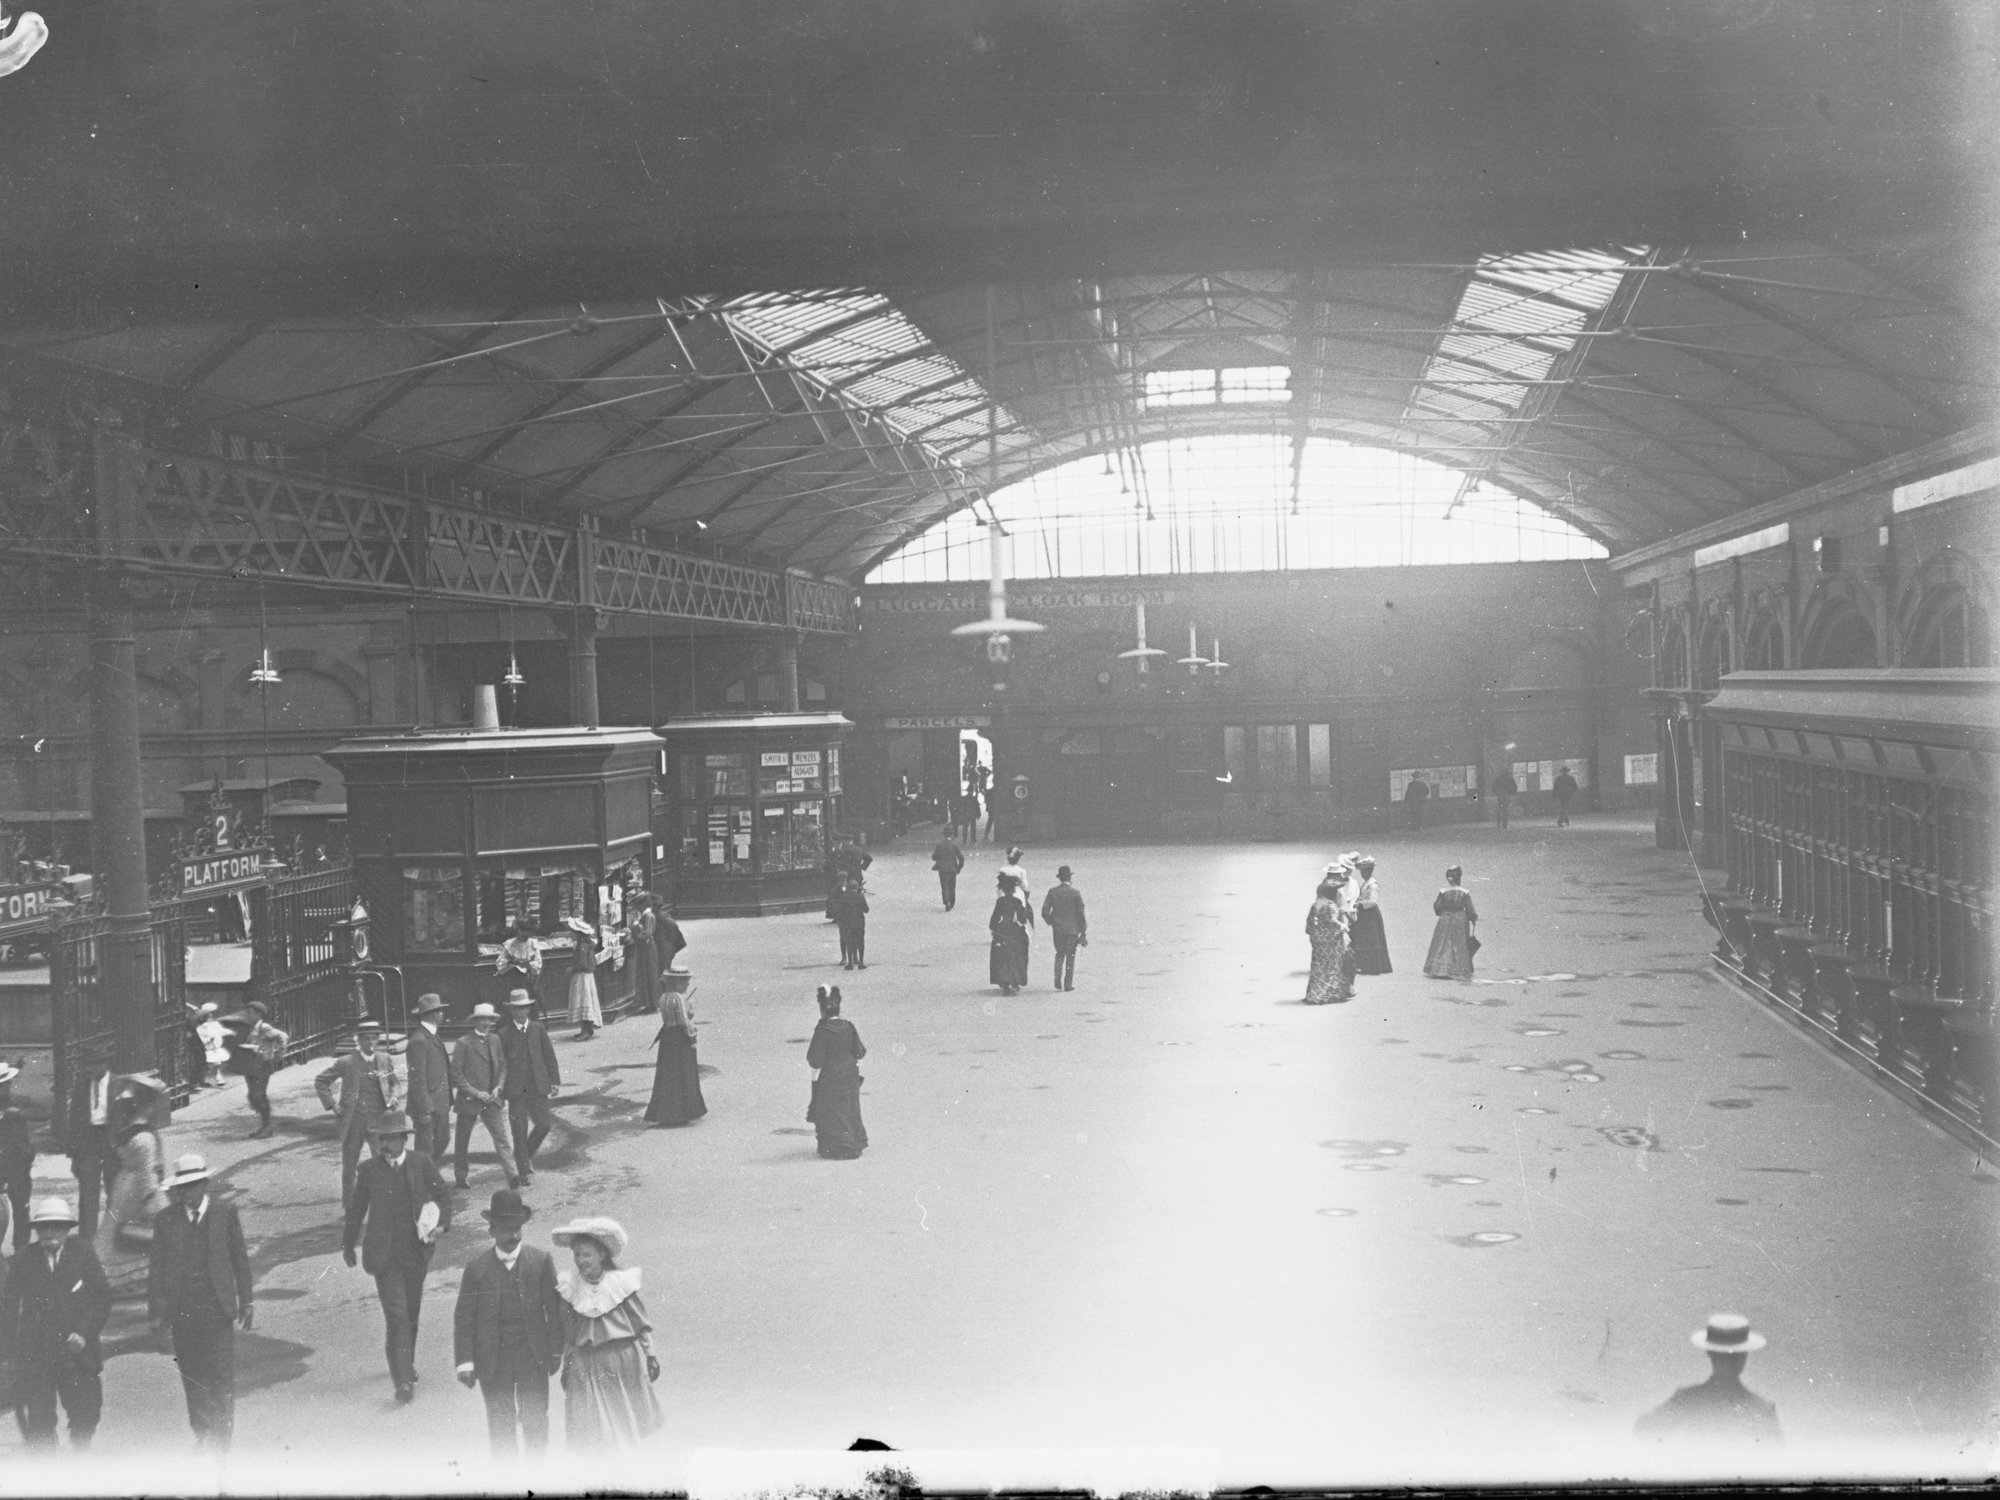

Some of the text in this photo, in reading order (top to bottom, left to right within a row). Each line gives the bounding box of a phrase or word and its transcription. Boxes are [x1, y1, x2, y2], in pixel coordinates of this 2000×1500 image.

[874, 590, 1165, 612] LUGGAGE CLOAK ROOM
[898, 718, 976, 729] PARCELS
[215, 814, 228, 846] 2
[183, 853, 260, 888] PLATFORM
